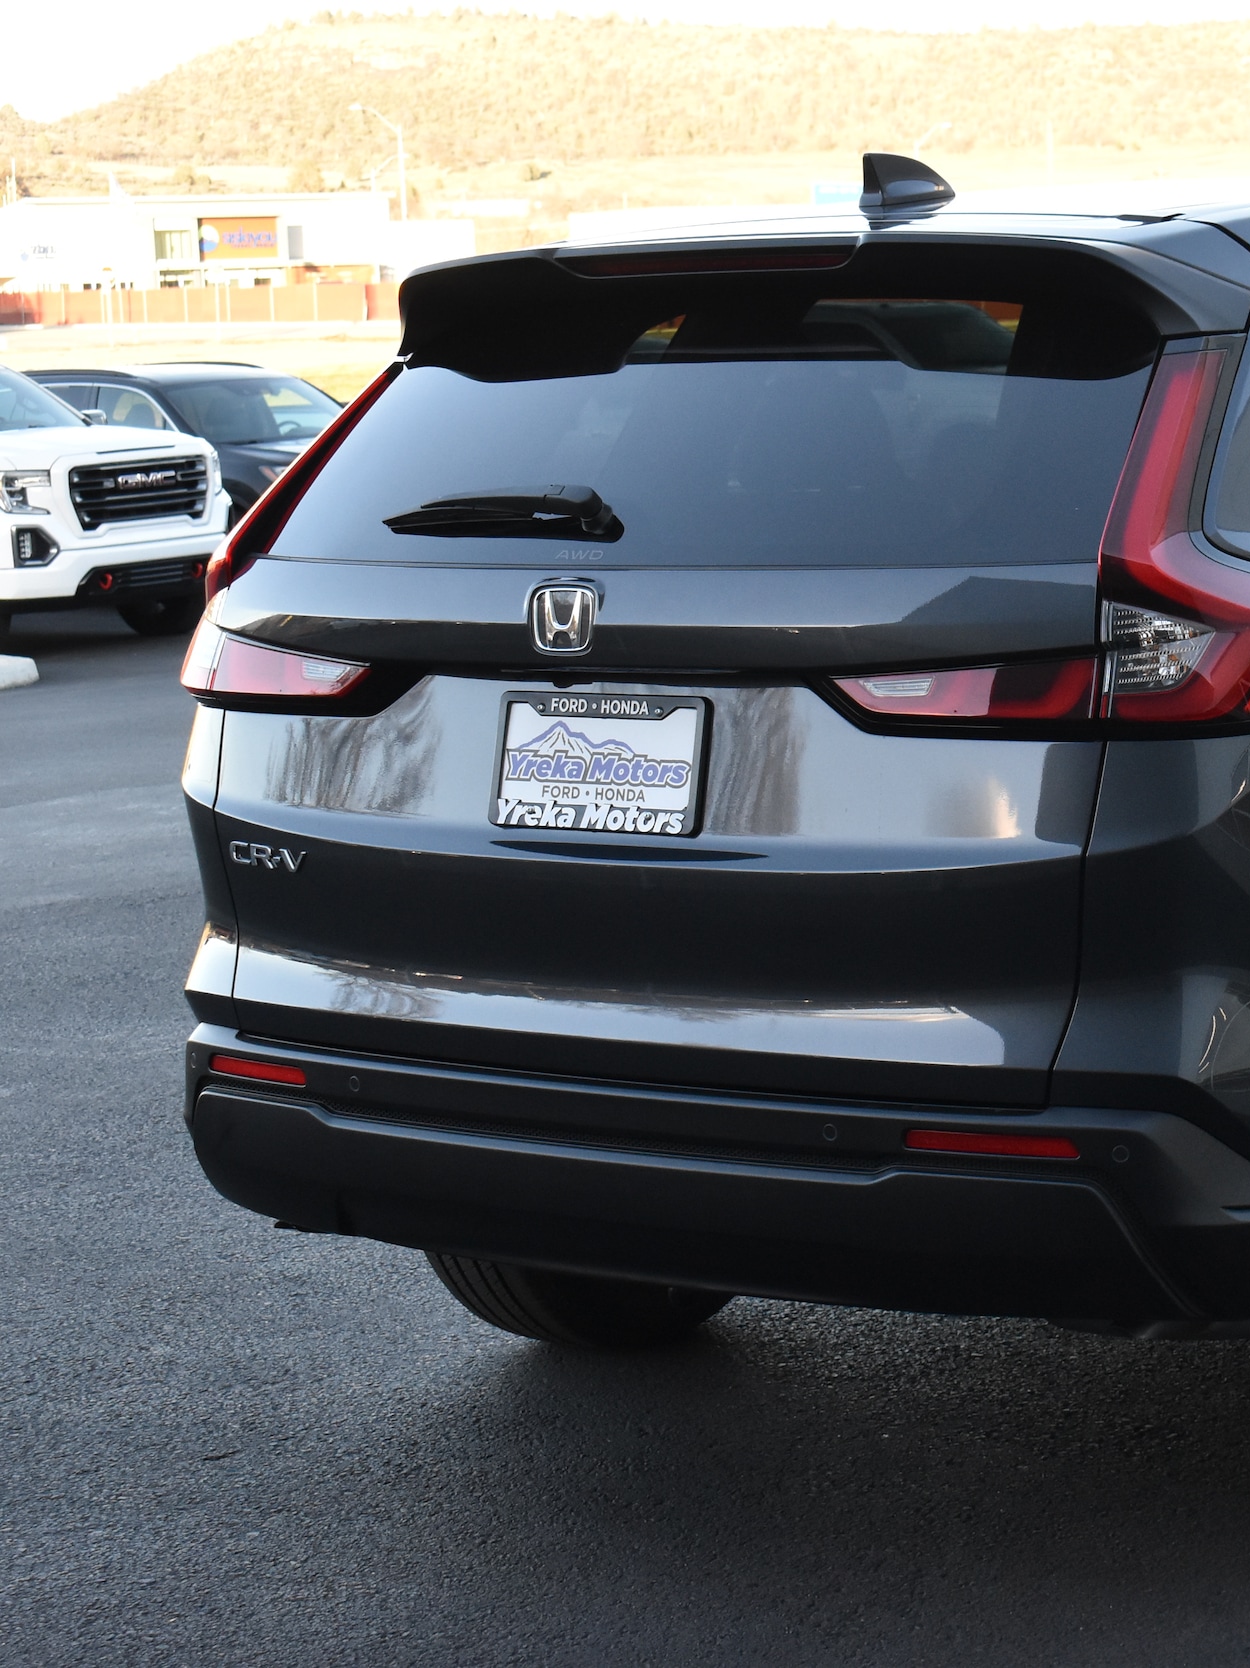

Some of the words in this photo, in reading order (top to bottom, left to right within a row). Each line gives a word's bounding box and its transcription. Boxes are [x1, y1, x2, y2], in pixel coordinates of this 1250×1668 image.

[117, 470, 177, 490] GMC
[555, 550, 604, 560] AWD
[551, 698, 587, 713] FORD
[600, 700, 649, 715] HONDA
[507, 750, 586, 783] Yreka
[586, 754, 691, 790] Motors
[541, 785, 580, 799] FORD
[594, 788, 645, 802] HONDA
[497, 798, 576, 828] Yreka
[579, 803, 685, 834] Motors
[229, 840, 307, 873] CR-V
